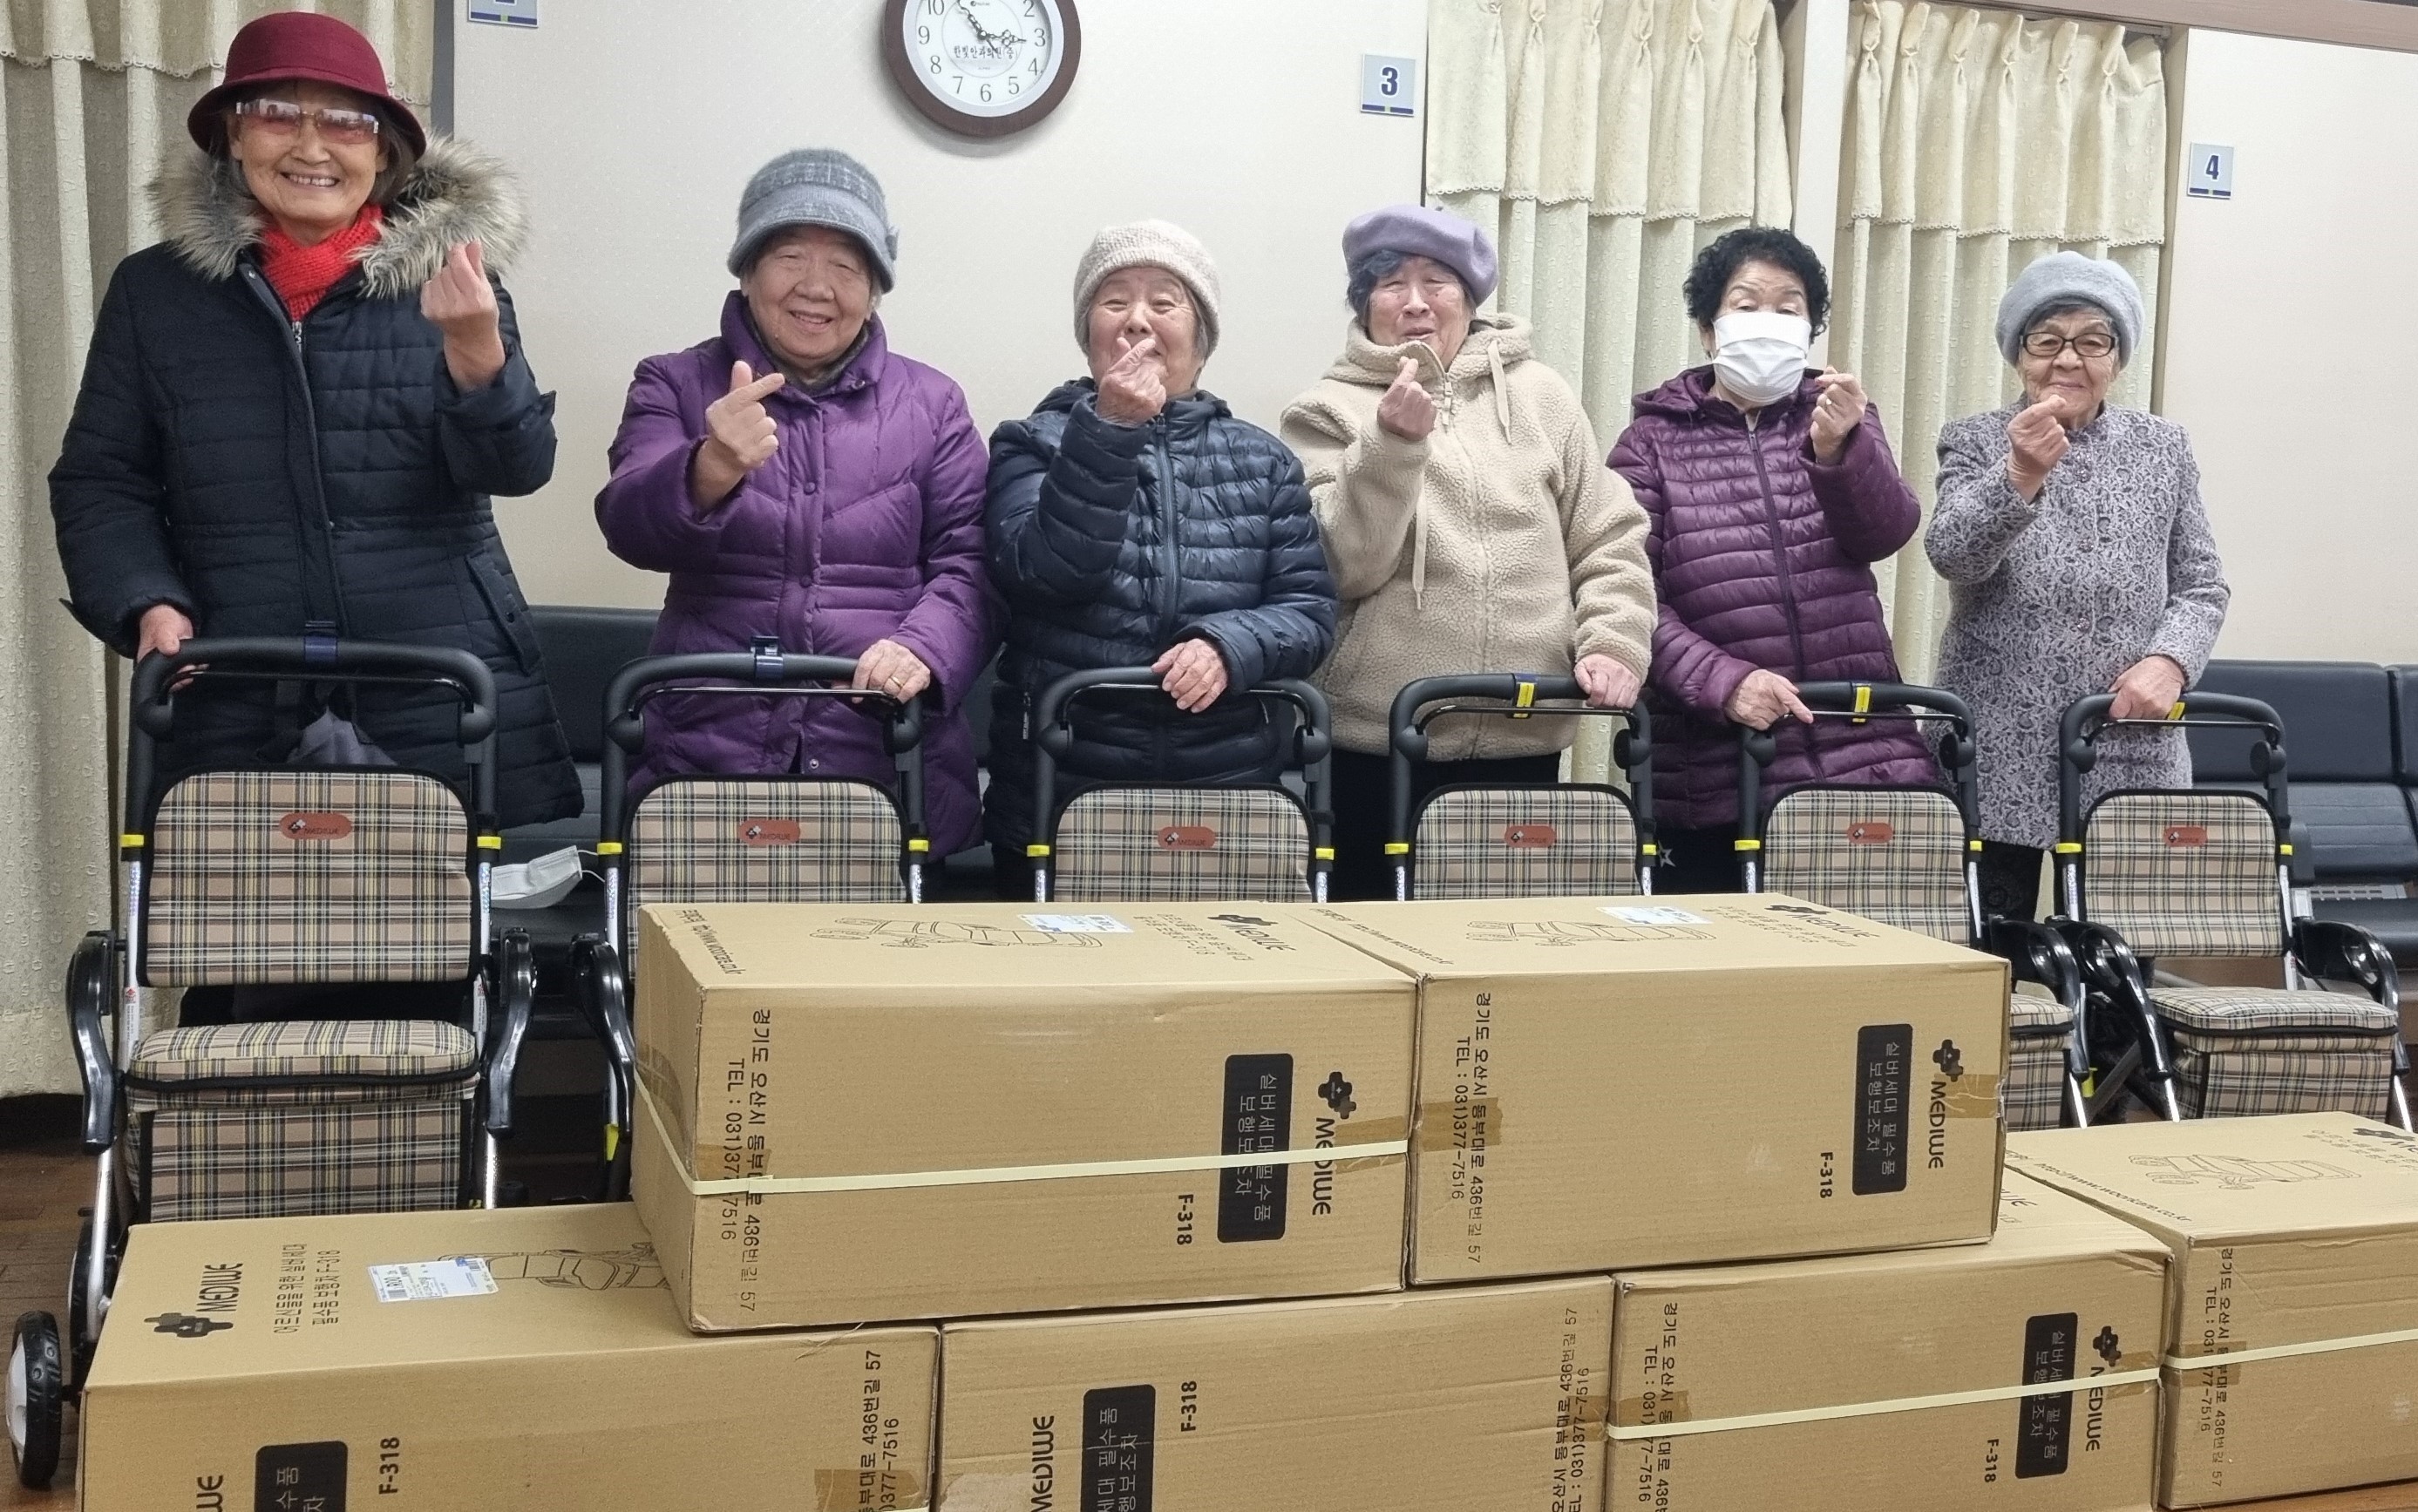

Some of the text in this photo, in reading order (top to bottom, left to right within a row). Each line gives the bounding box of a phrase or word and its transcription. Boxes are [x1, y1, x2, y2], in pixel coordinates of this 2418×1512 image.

[918, 25, 930, 44] 9
[1034, 28, 1046, 47] 3
[930, 55, 941, 74] 8
[953, 76, 963, 94] 7
[1009, 76, 1020, 95] 5
[1028, 58, 1038, 76] 4
[1381, 66, 1398, 96] 3
[980, 83, 992, 102] 6
[2205, 154, 2219, 180] 4
[752, 1008, 771, 1063] 경기도
[1475, 993, 1491, 1040] 경기도
[1456, 1036, 1470, 1067] TEL
[1473, 1049, 1489, 1095] 오산시
[727, 1058, 745, 1093] TEL
[748, 1072, 768, 1126] 오산시
[1866, 1062, 1884, 1152] 보행보조차
[1881, 1041, 1900, 1176] 실버세대 필수품
[1928, 1081, 1947, 1170] MEDIWE
[1253, 1073, 1278, 1222] 실버세대 필수품
[1450, 1085, 1470, 1200] 031)377-7516
[1470, 1104, 1487, 1170] 동부대로
[745, 1135, 764, 1207] 동부로
[1312, 1117, 1335, 1217] MEDIWE
[1819, 1151, 1834, 1199] F-318
[1176, 1194, 1194, 1246] F-318
[195, 1264, 243, 1312] MEDIWE
[2221, 1248, 2233, 1290] 경기도
[739, 1292, 756, 1312] 57
[2205, 1286, 2218, 1315] TEL
[2218, 1297, 2231, 1339] 오산시
[1663, 1302, 1678, 1349] 경기도
[866, 1351, 881, 1371] 57
[1644, 1345, 1659, 1375] TEL
[1660, 1356, 1675, 1402] 오산시
[2048, 1330, 2066, 1400] 실버세
[1180, 1380, 1198, 1433] F-318
[1554, 1399, 1570, 1461] 동부대로
[1565, 1308, 1578, 1326] 57
[862, 1380, 880, 1446] 436번길
[1570, 1367, 1590, 1479] 031)377-7516
[1097, 1407, 1117, 1468] 필수품
[1638, 1391, 1657, 1502] 031)77-7516
[1657, 1409, 1673, 1472] 동대로
[1984, 1438, 2000, 1483] F-318
[379, 1437, 400, 1495] F-318
